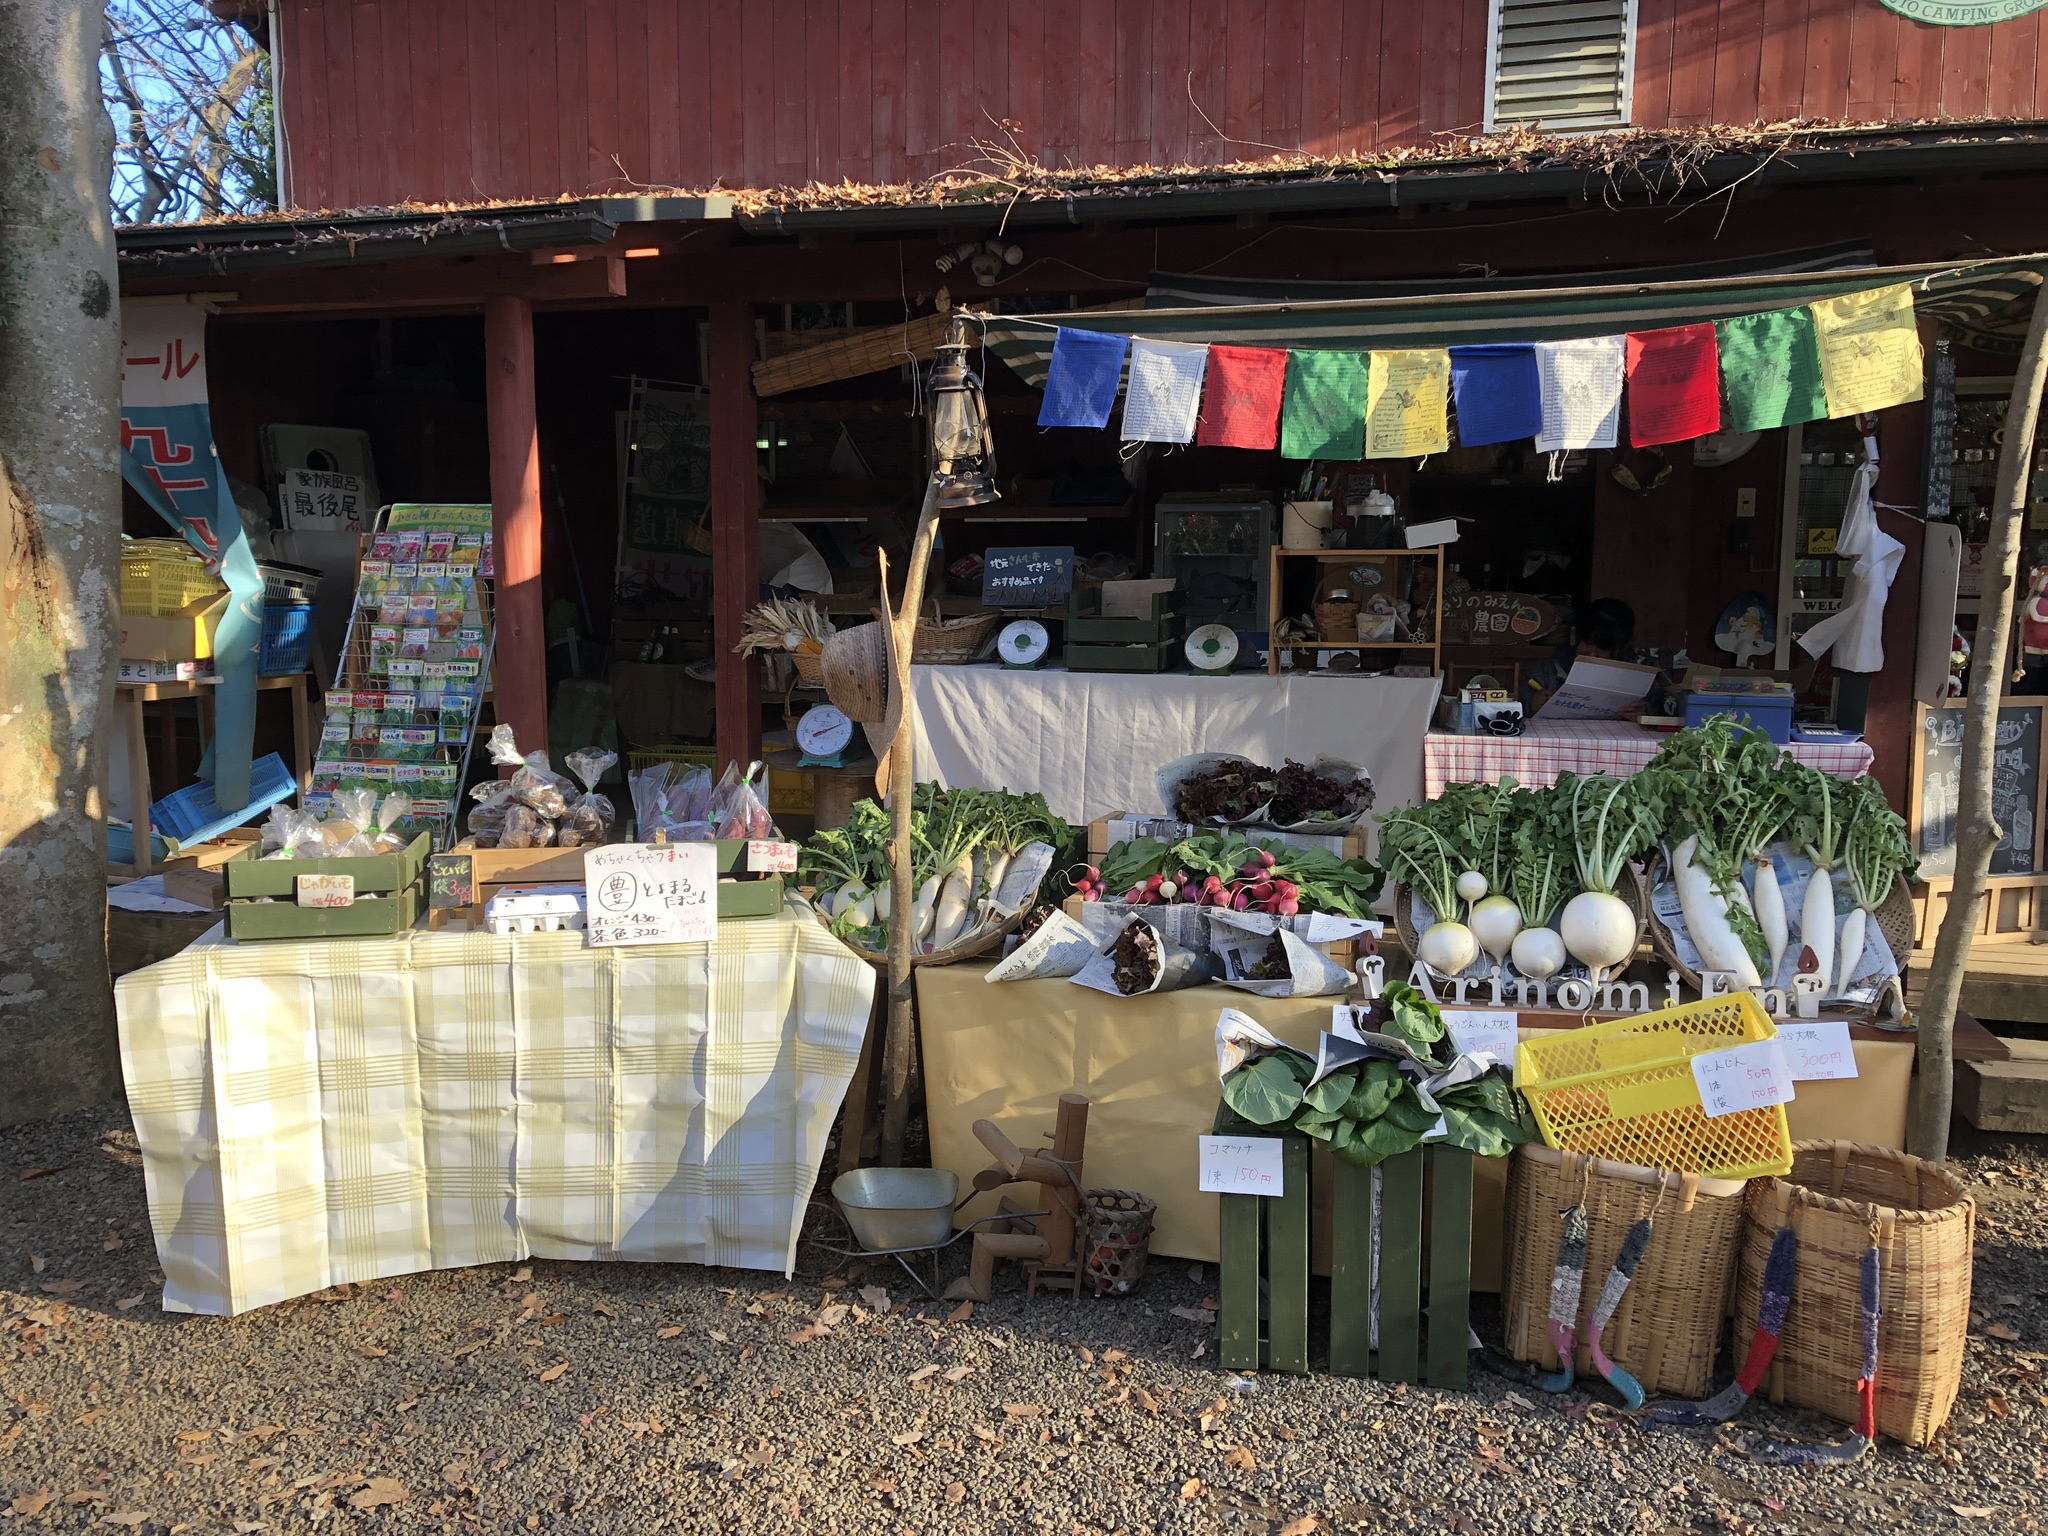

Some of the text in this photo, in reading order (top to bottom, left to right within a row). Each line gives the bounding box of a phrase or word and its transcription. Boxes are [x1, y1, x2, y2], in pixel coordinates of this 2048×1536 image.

[1922, 6, 1999, 21] CAMPING
[2003, 0, 2043, 14] GRO
[122, 338, 199, 381] ール
[296, 471, 359, 492] 家族風呂
[294, 491, 360, 521] 最後尾
[1026, 561, 1051, 572] できた
[991, 575, 1044, 588] おすすめ品です
[1473, 609, 1511, 633] 農園
[1551, 699, 1618, 715] 九十九里オーシャンビー
[594, 849, 689, 866] めちゃくちゃうまい
[750, 842, 796, 858] さつまいも
[299, 876, 352, 891] じゃがいも
[590, 927, 629, 943] 茶色
[1774, 1030, 1823, 1043] うら大根
[1701, 1056, 1747, 1074] にんじん
[1798, 1048, 1842, 1068] 300円
[1751, 1086, 1778, 1100] 150円
[1209, 1144, 1253, 1155] コマツナ
[1233, 1165, 1271, 1186] 150円
